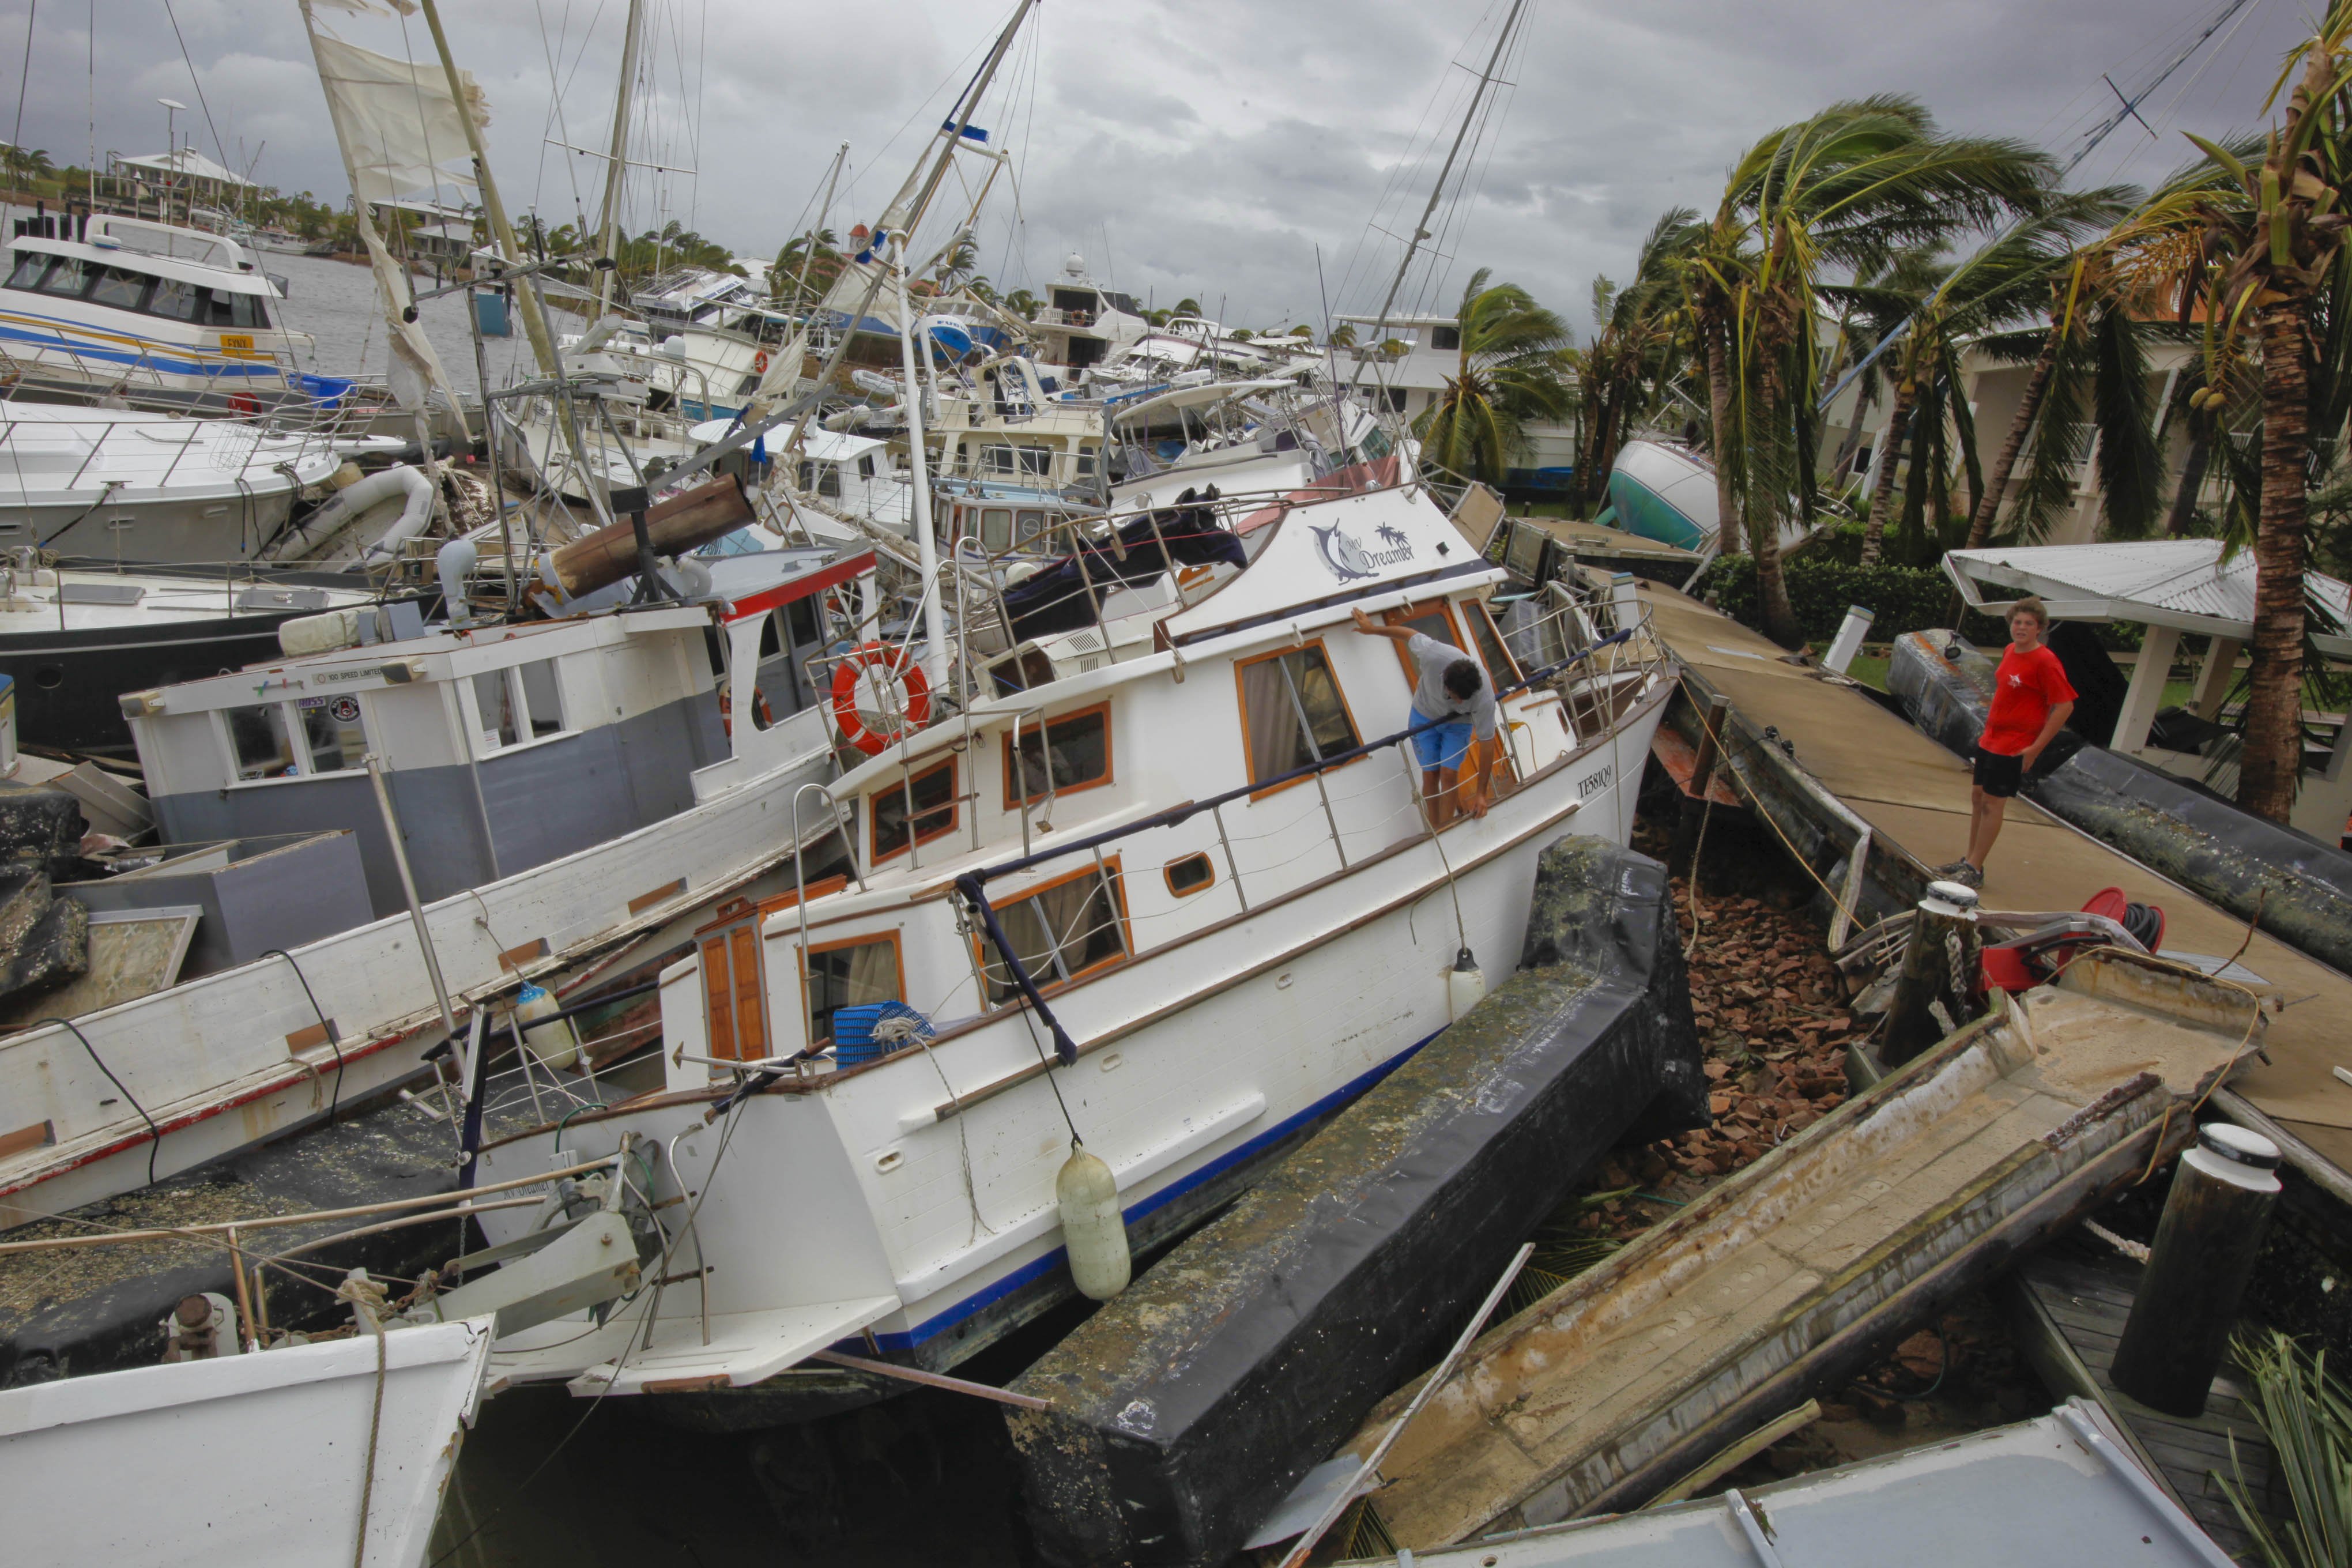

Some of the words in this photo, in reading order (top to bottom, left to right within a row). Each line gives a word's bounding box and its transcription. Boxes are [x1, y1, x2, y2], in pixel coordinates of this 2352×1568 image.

[1345, 537, 1362, 551] MV
[1359, 546, 1415, 568] Dreamer
[341, 671, 358, 679] SPEED
[360, 668, 382, 677] LIMITED
